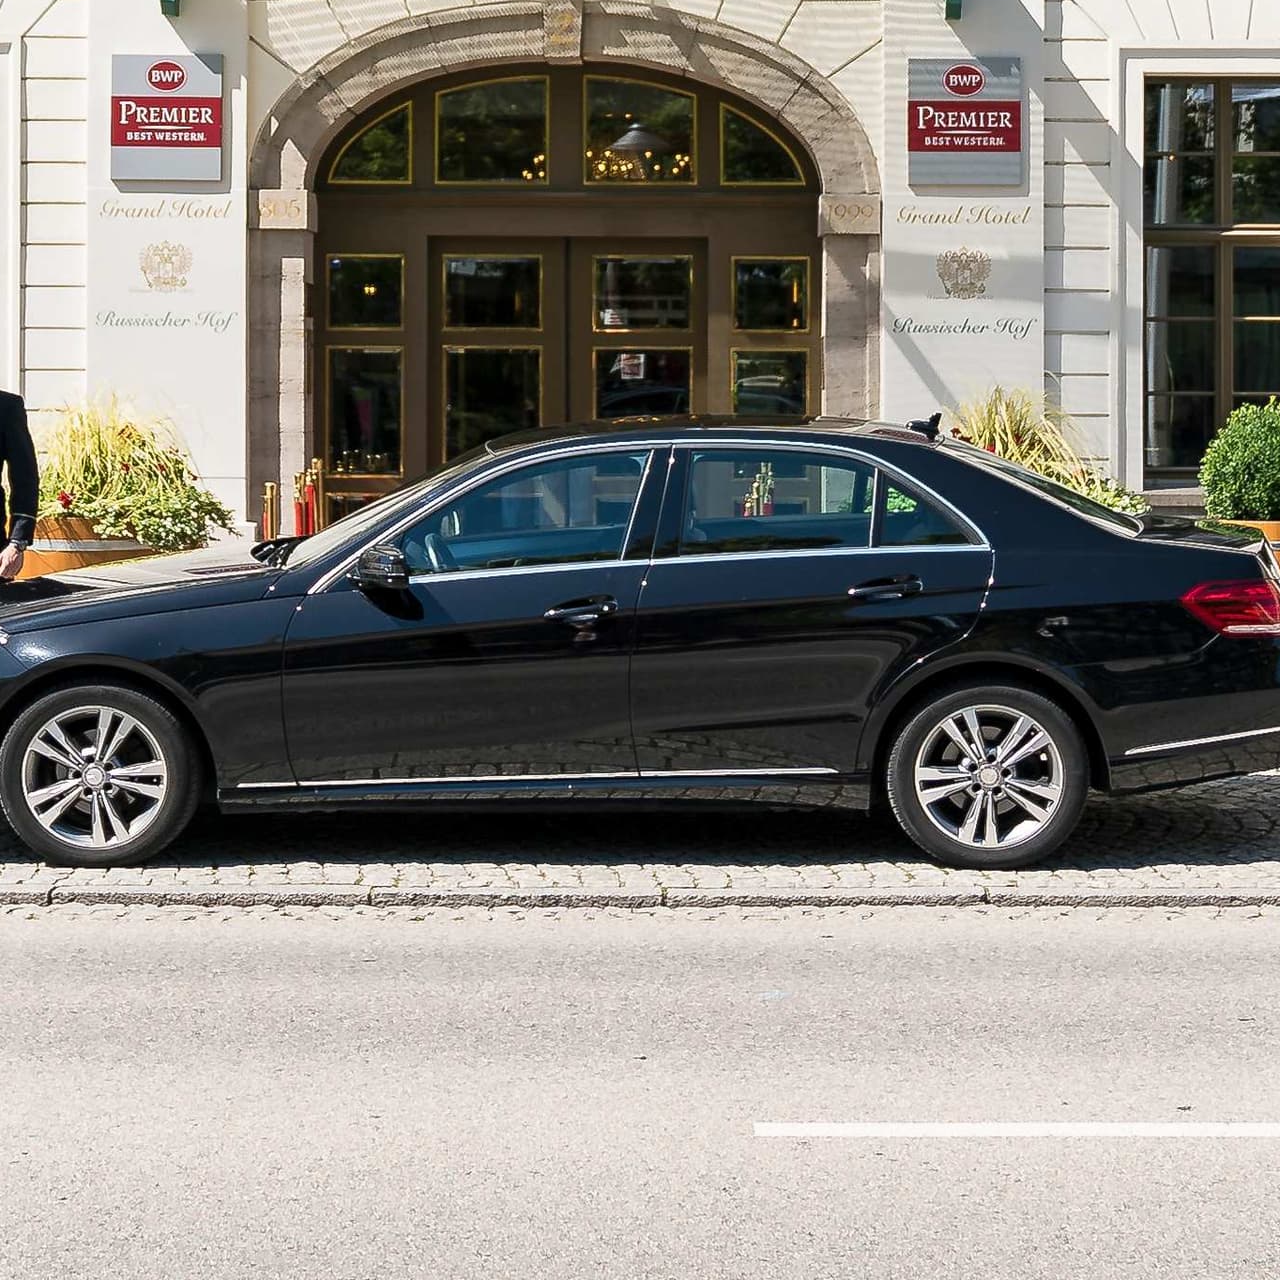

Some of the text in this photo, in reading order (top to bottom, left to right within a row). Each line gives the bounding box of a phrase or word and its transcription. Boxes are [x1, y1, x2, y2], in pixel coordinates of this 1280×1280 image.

[150, 69, 183, 83] BWP
[948, 74, 981, 87] BWP
[119, 100, 214, 125] PREMIER
[916, 105, 1013, 129] PREMIER
[126, 131, 205, 142] BEST WESTERN
[924, 136, 1004, 147] BEST WESTERN
[99, 199, 233, 219] Grand Hotel
[896, 205, 1032, 225] Grand Hotel
[95, 310, 238, 333] Russischer Hof
[892, 317, 1038, 341] Russischer Hof
